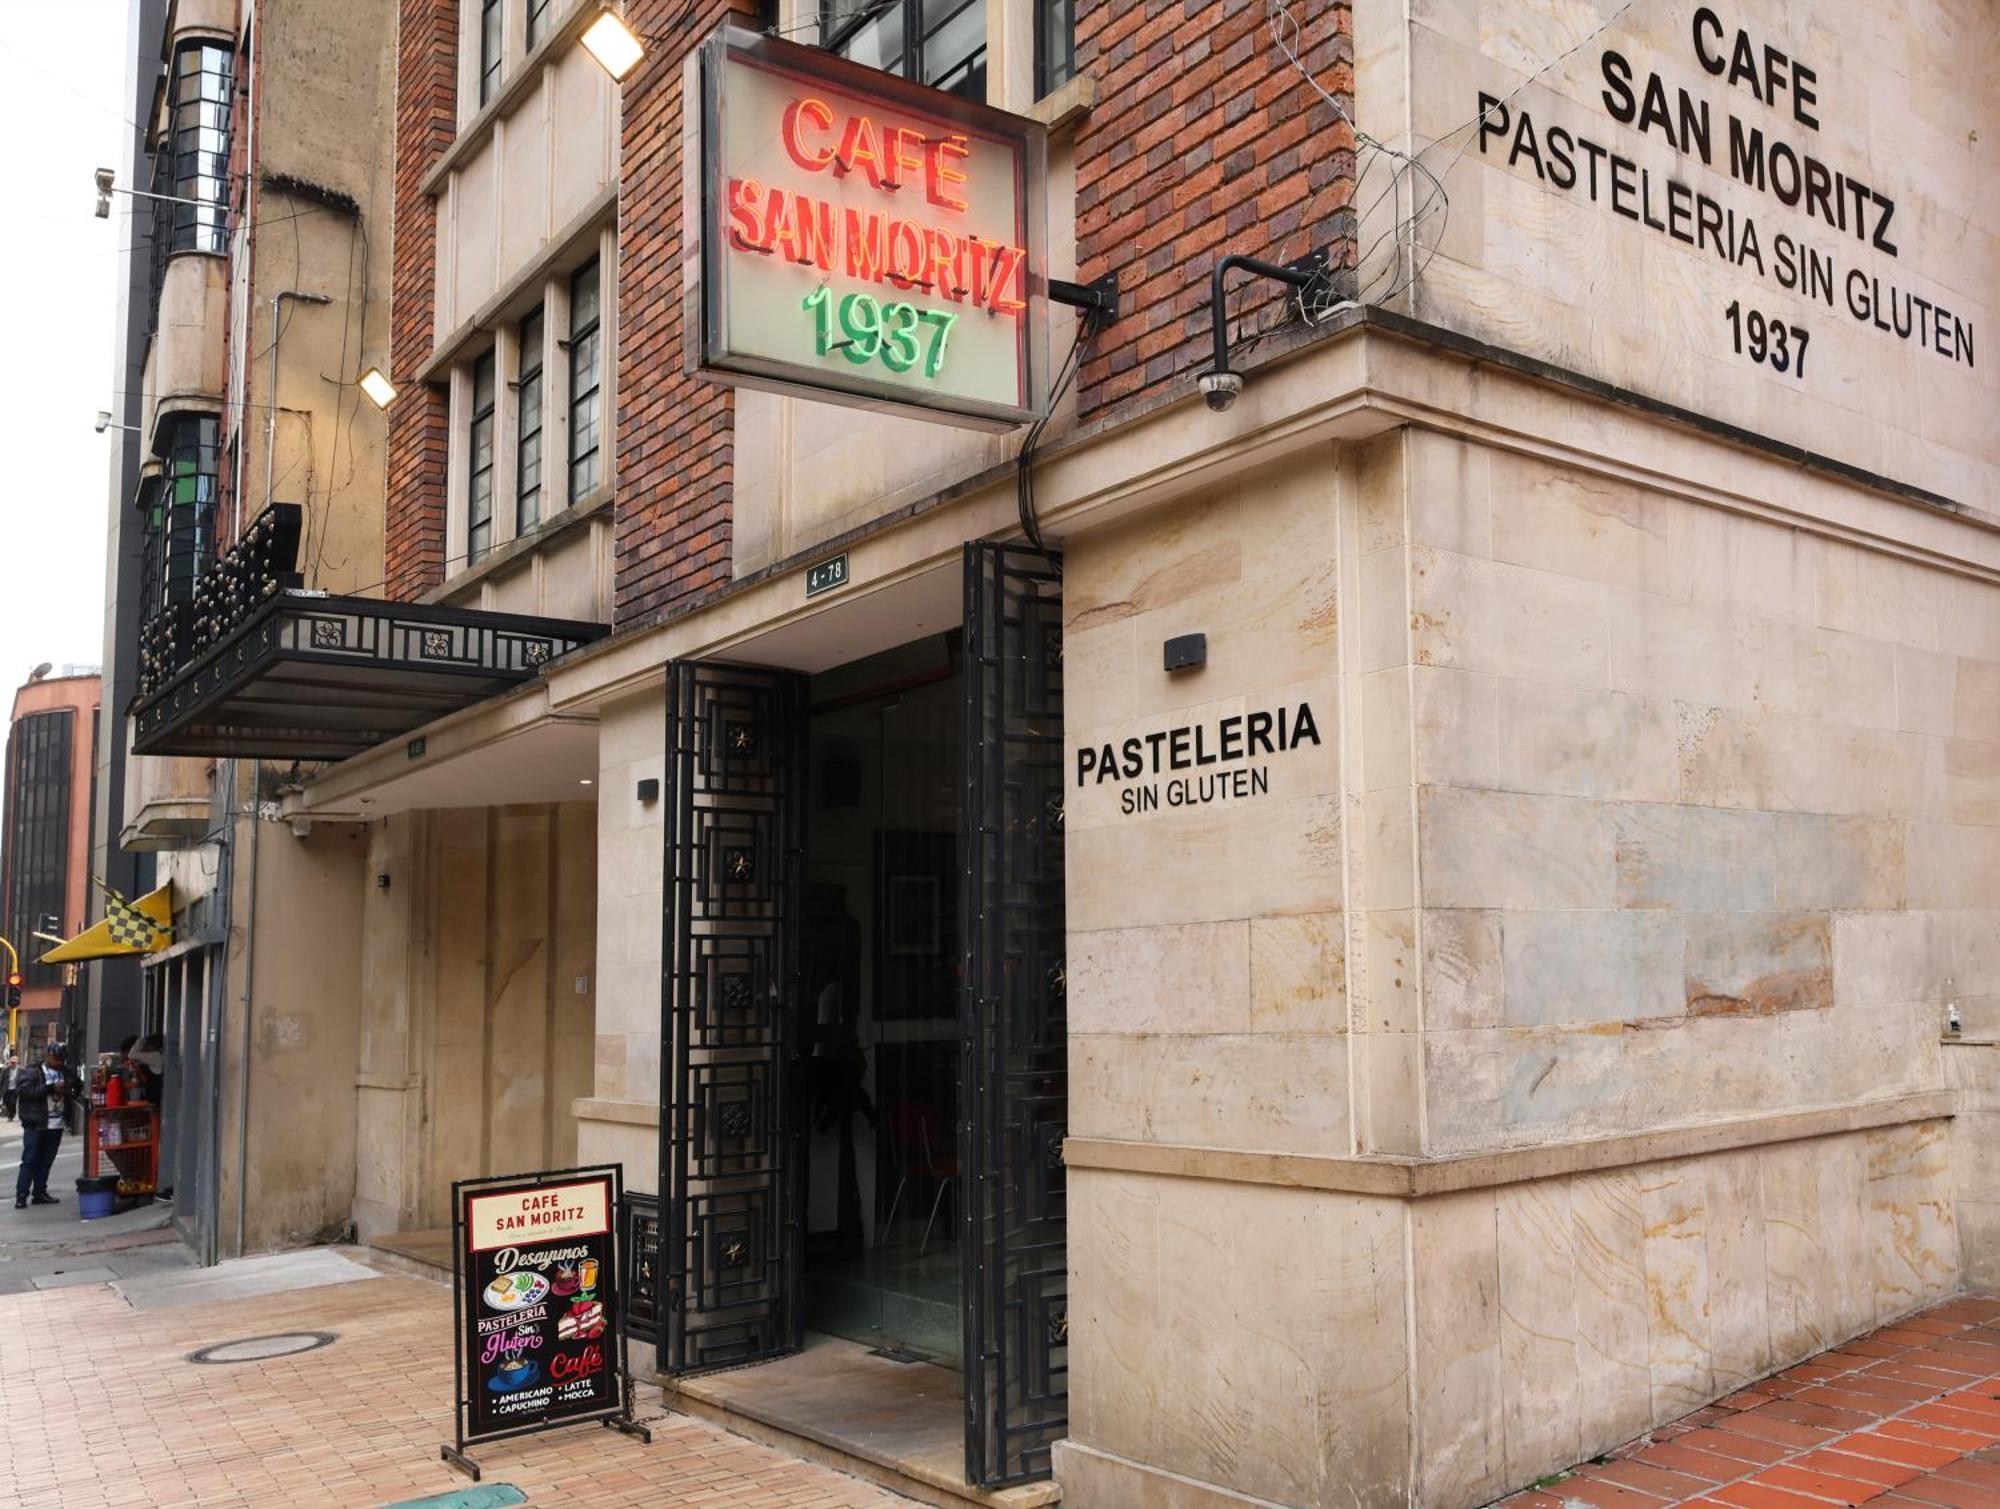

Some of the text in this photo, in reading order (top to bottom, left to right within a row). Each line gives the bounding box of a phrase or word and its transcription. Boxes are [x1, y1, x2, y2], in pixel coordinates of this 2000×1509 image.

[1692, 7, 1819, 131] CAFE
[1601, 50, 1898, 257] SAN MORITZ
[729, 178, 1026, 317] SAN MORITZ
[1478, 91, 1974, 367] PASTELERIA SIN GLUTEN
[802, 287, 958, 378] 1937
[1725, 300, 1810, 378] 1937
[1077, 702, 1321, 787] PASTELERIA
[1121, 766, 1268, 814] SIN GLUTEN
[496, 1207, 584, 1231] SAN MORITZ
[494, 1244, 589, 1274] Desayunos
[518, 1325, 536, 1336] Sin
[550, 1345, 604, 1379] Café
[499, 1386, 553, 1405] AMERICANO
[499, 1397, 550, 1414] CAPUCHINO
[564, 1379, 592, 1392] LATTE
[564, 1388, 595, 1401] MOCCA
